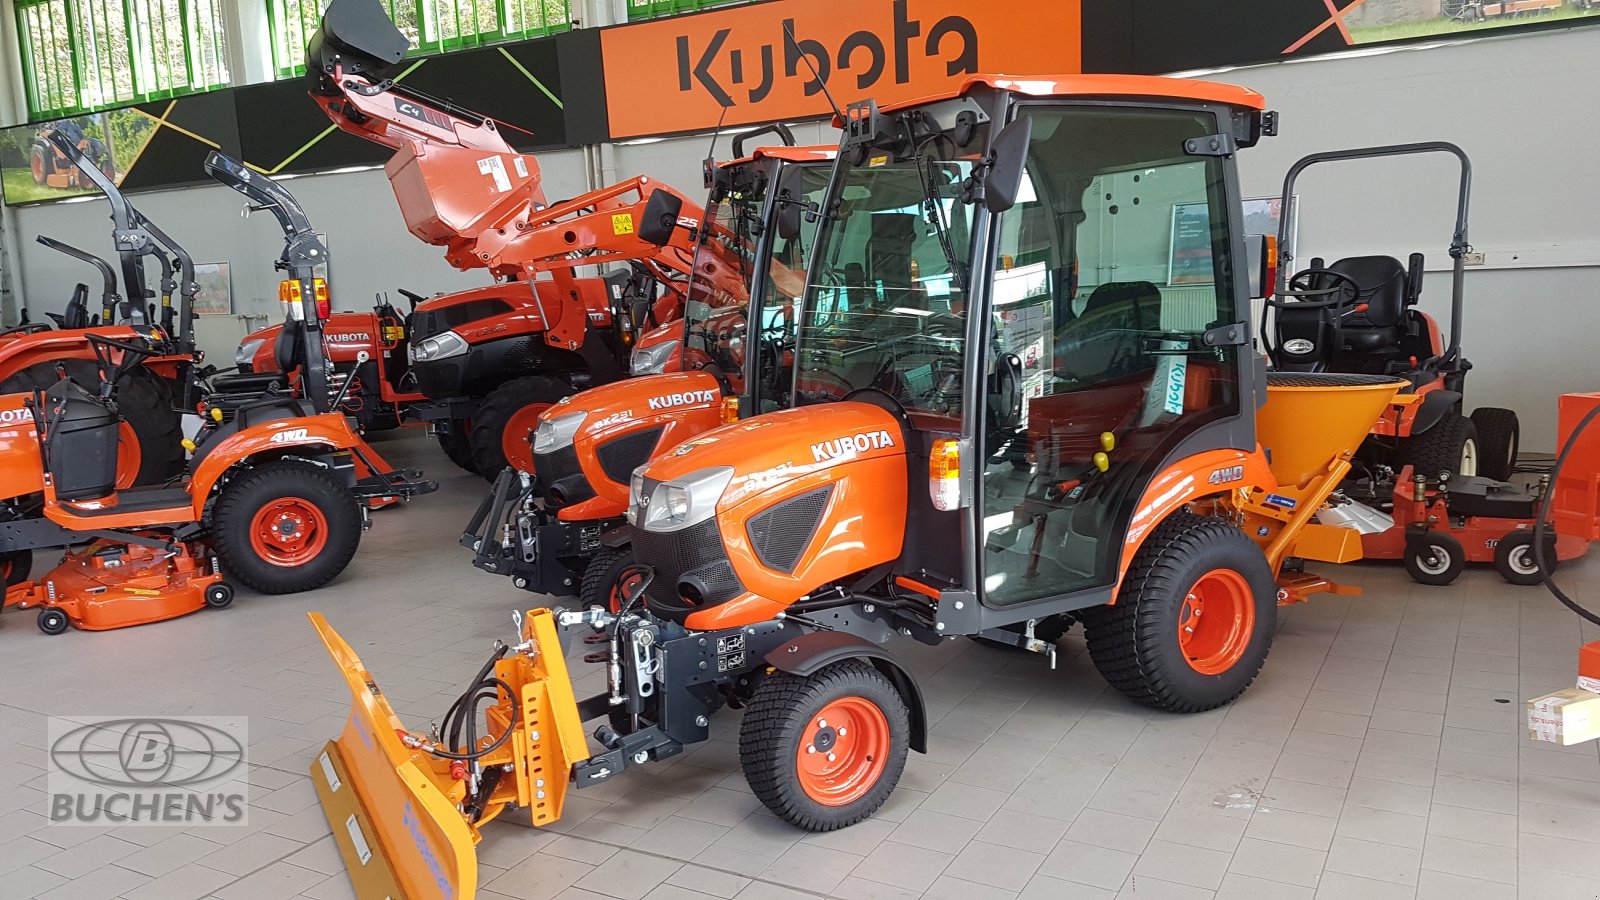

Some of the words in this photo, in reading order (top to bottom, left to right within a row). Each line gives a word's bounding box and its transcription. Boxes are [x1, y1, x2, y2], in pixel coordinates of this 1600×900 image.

[676, 0, 978, 107] Kubota
[399, 103, 420, 117] C4
[677, 216, 698, 227] 25
[325, 333, 370, 342] KUBOTA
[648, 390, 714, 410] KUBOTA
[0, 408, 34, 422] OTA
[270, 429, 307, 442] 4WD
[810, 430, 895, 463] KUBOTA
[1208, 465, 1244, 485] 4WD
